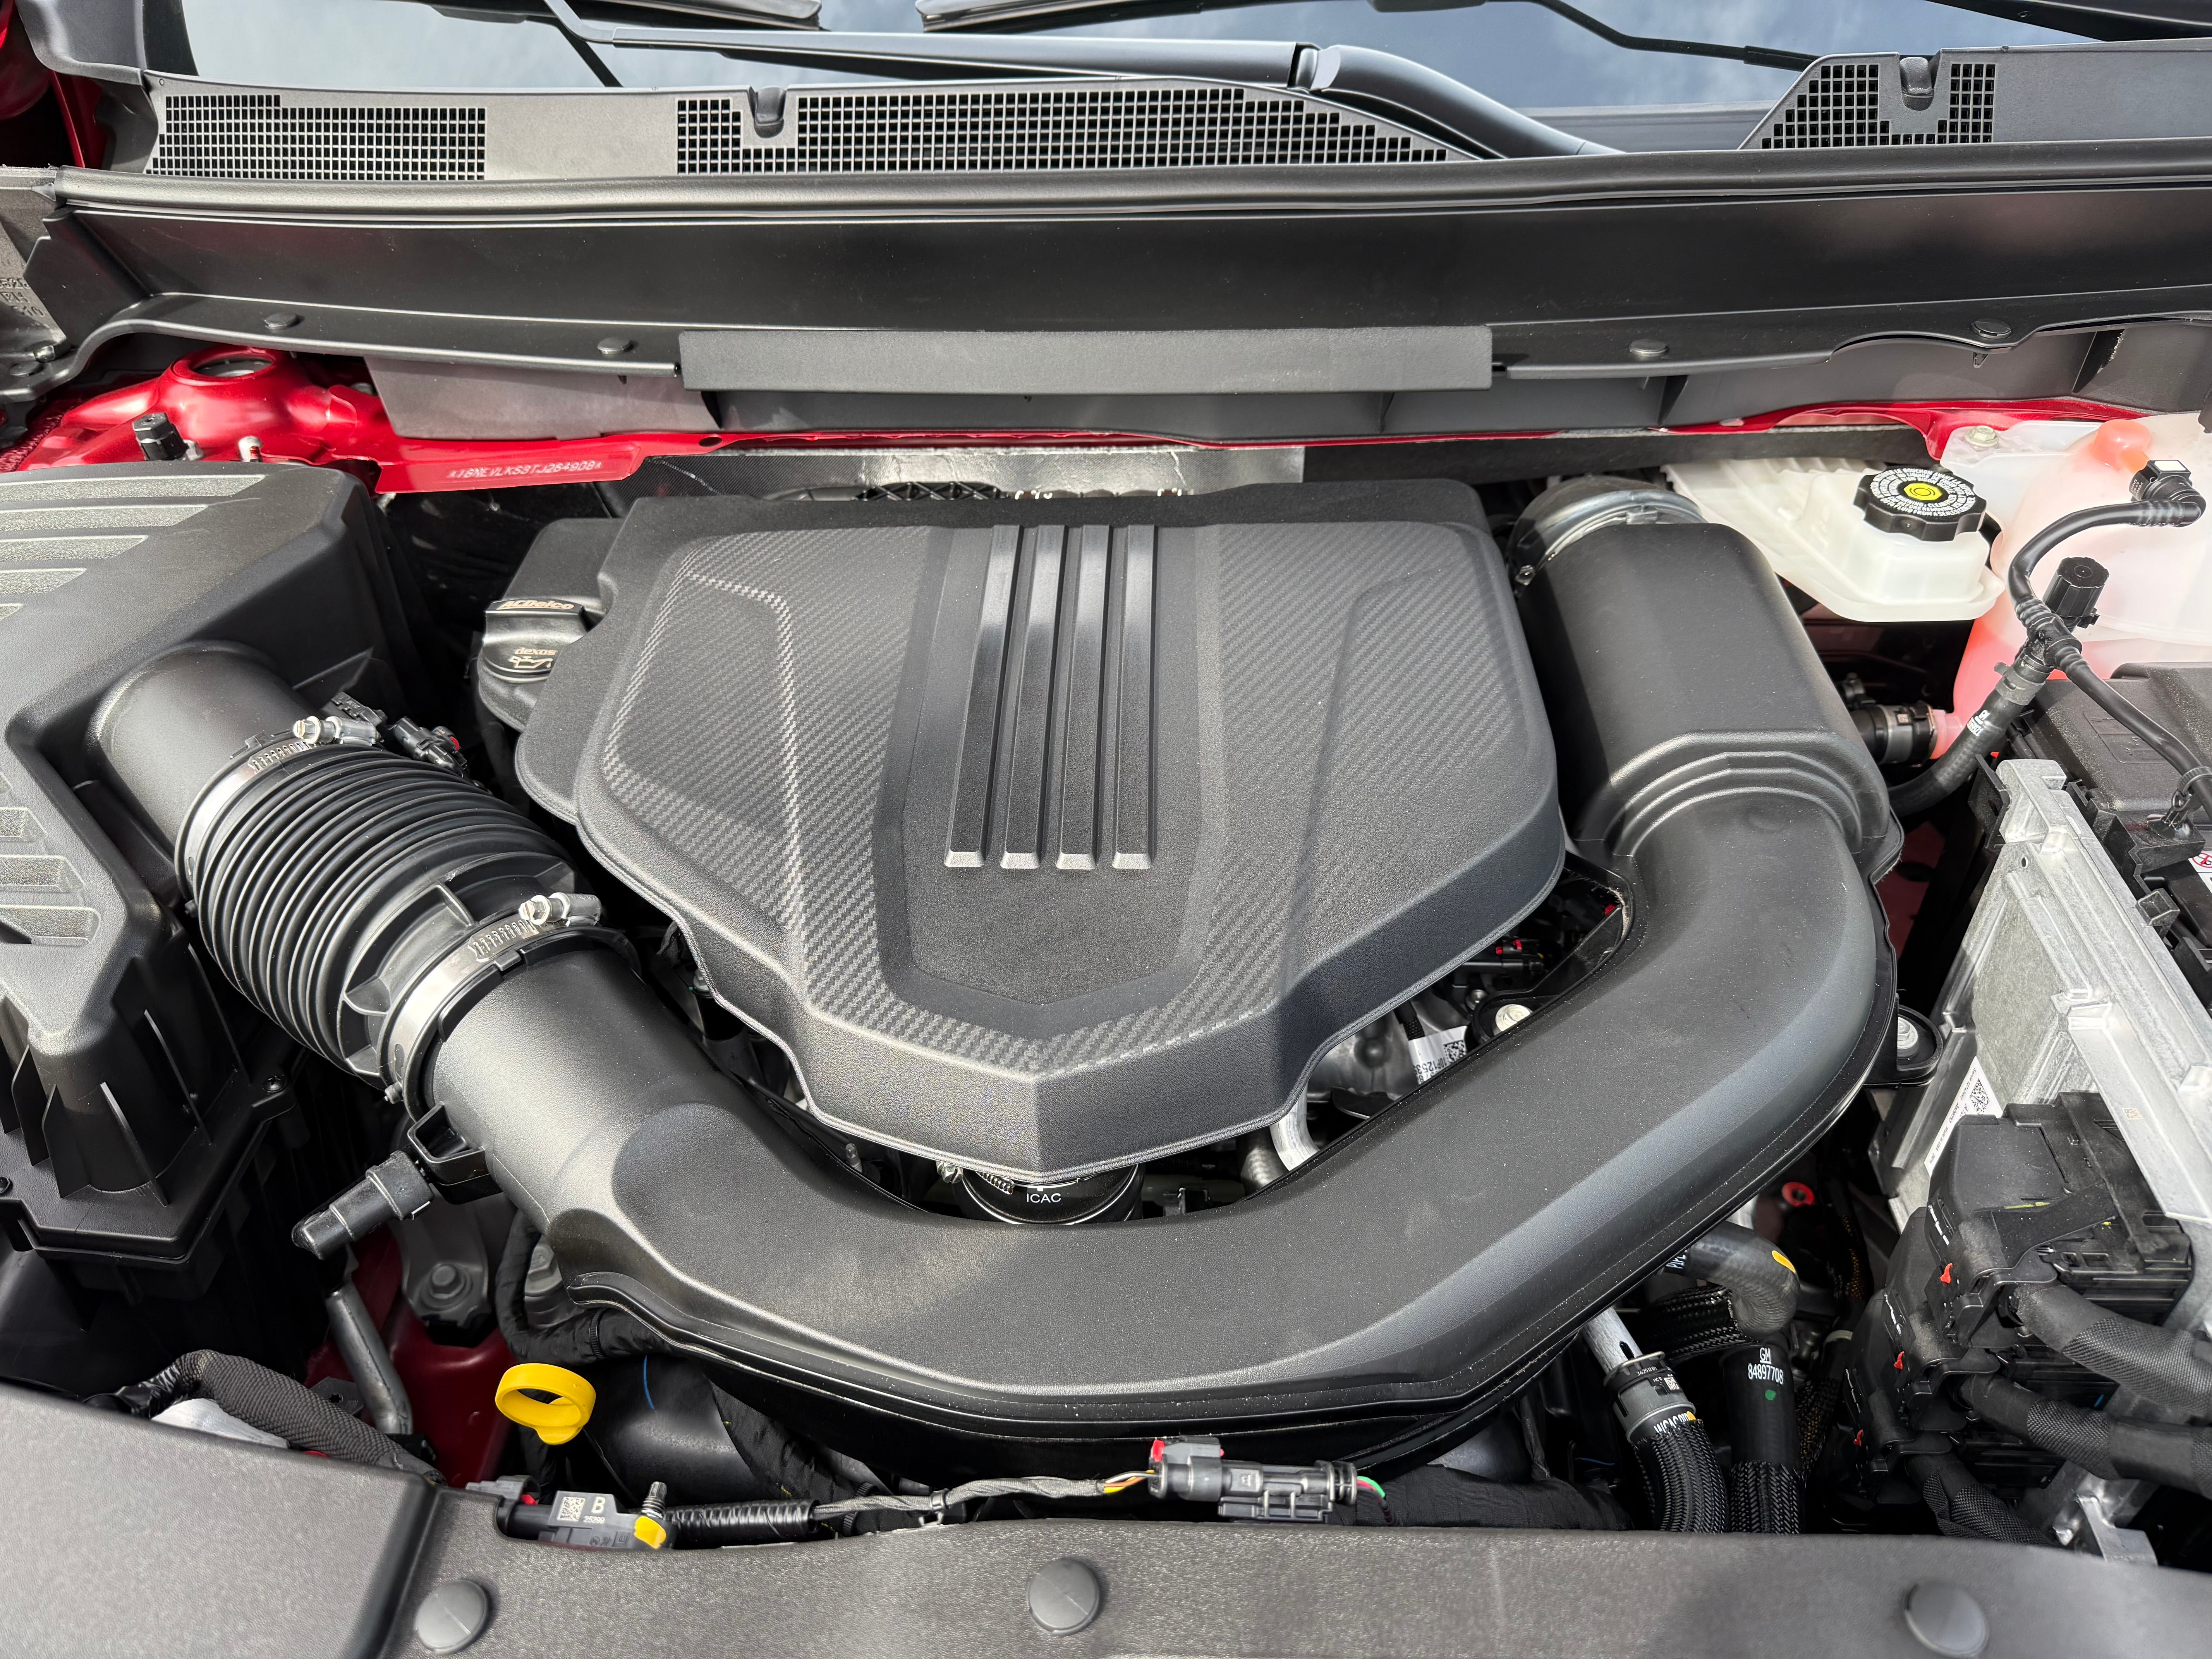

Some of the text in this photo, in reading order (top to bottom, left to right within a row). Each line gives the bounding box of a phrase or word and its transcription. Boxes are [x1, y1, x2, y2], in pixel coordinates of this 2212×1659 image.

[1932, 472, 1954, 481] AVANT
[1893, 504, 1913, 513] FLUID
[1897, 501, 1922, 510] BEFORE
[500, 600, 574, 610] ACDelco
[515, 647, 557, 655] dexos
[1026, 1192, 1061, 1203] ICAC
[1759, 1347, 1771, 1363] GM
[1748, 1363, 1783, 1385] 84897708
[591, 1496, 606, 1513] B
[583, 1515, 605, 1524] 25299
